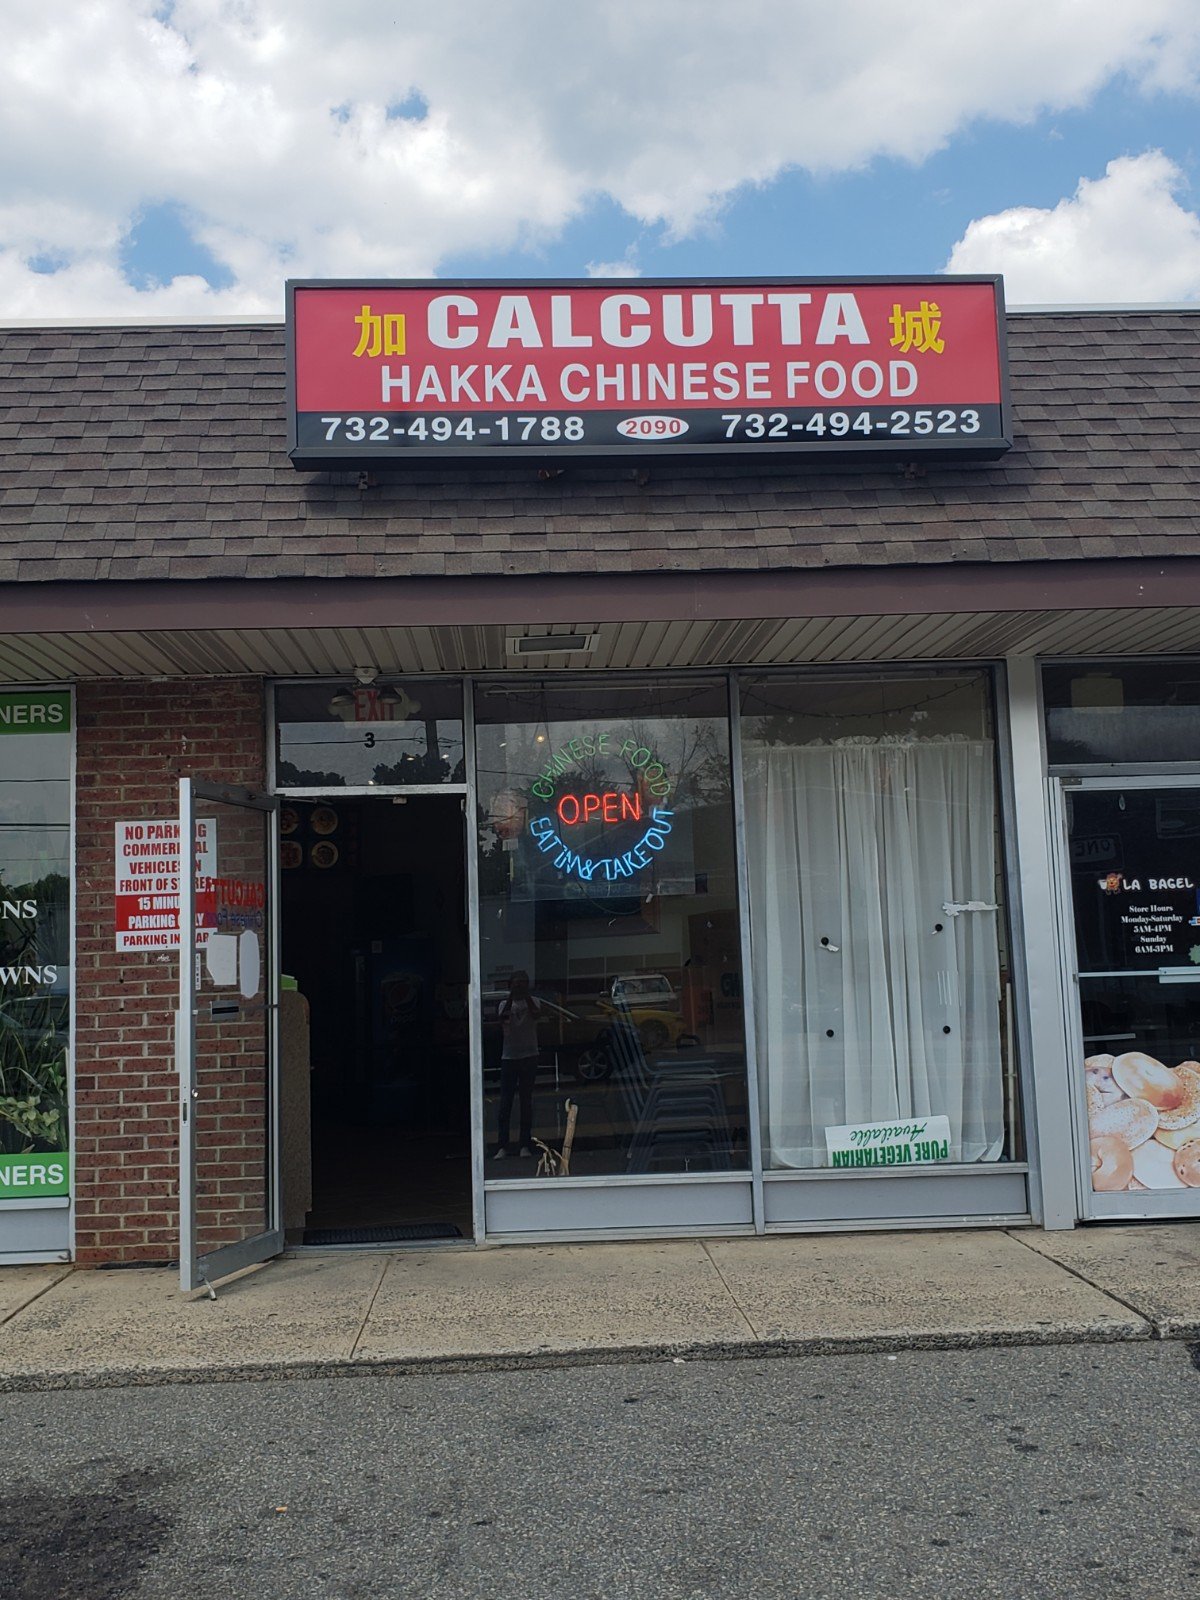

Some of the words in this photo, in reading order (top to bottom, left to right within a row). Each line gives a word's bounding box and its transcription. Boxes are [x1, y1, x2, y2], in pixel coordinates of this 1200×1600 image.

[352, 305, 406, 358] 加
[427, 293, 871, 349] CALCUTTA
[888, 301, 945, 354] 城
[381, 364, 547, 403] HAKKA
[559, 361, 772, 402] CHINESE
[786, 359, 918, 399] FOOD
[321, 416, 585, 441] 732-494-1788
[625, 419, 681, 436] 2090
[721, 409, 981, 438] 732-494-2523
[0, 703, 64, 724] NERS
[364, 732, 375, 748] 3
[532, 734, 611, 798] CHINESE
[619, 739, 671, 796] FOOD
[557, 792, 640, 825] OPEN
[125, 825, 143, 840] NO
[147, 823, 207, 839] PARKG
[530, 817, 561, 853] EAT
[129, 861, 180, 875] VEHICLE
[120, 878, 153, 892] FRONT
[156, 878, 168, 891] OF
[1122, 879, 1140, 890] LA
[1148, 877, 1194, 890] BAGEL
[0, 899, 38, 919] NS
[138, 896, 150, 910] 15
[153, 895, 181, 910] MINU
[1150, 904, 1173, 912] Hours
[128, 914, 175, 929] PARKING
[1121, 914, 1183, 924] Monday-Saturday
[123, 933, 167, 946] PARKING
[170, 933, 180, 944] IN
[1140, 935, 1167, 943] Sunday
[849, 1122, 928, 1147] Available
[832, 1143, 912, 1167] VEGETARIAN
[914, 1139, 948, 1162] PURE
[0, 1163, 64, 1186] NERS
